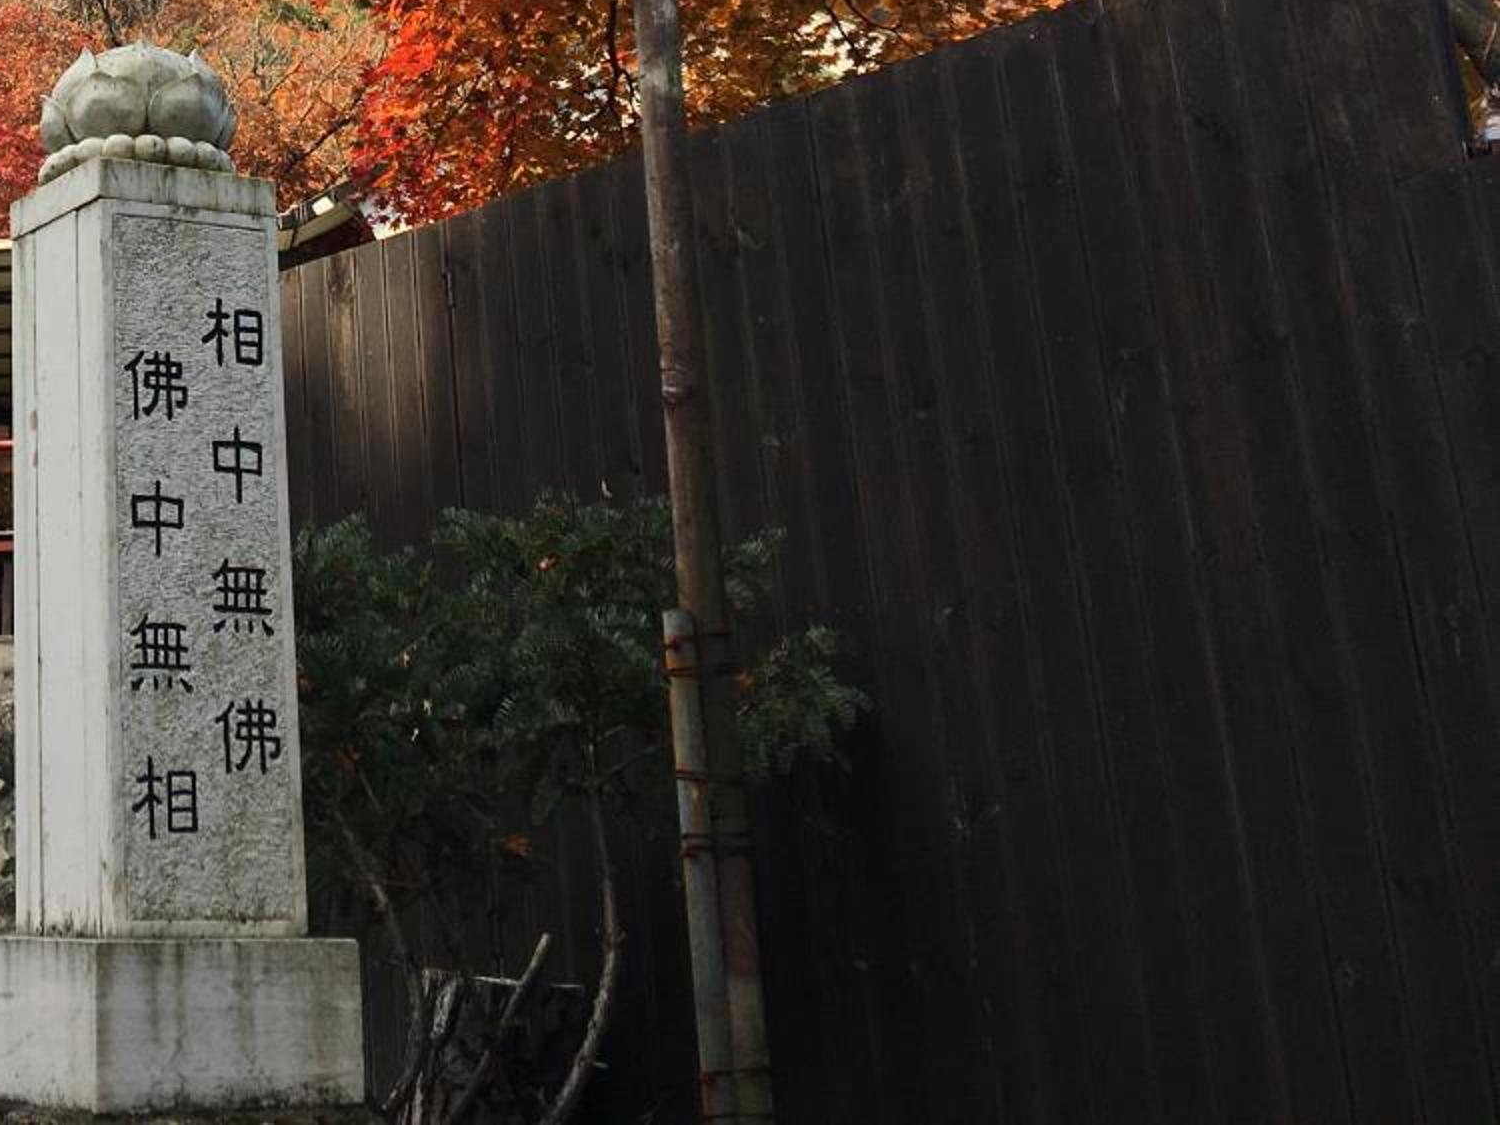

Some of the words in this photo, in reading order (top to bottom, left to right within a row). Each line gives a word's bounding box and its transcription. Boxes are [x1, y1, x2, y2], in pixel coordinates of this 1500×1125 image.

[123, 349, 199, 841] 佛中無相
[201, 296, 282, 776] 相中無佛
